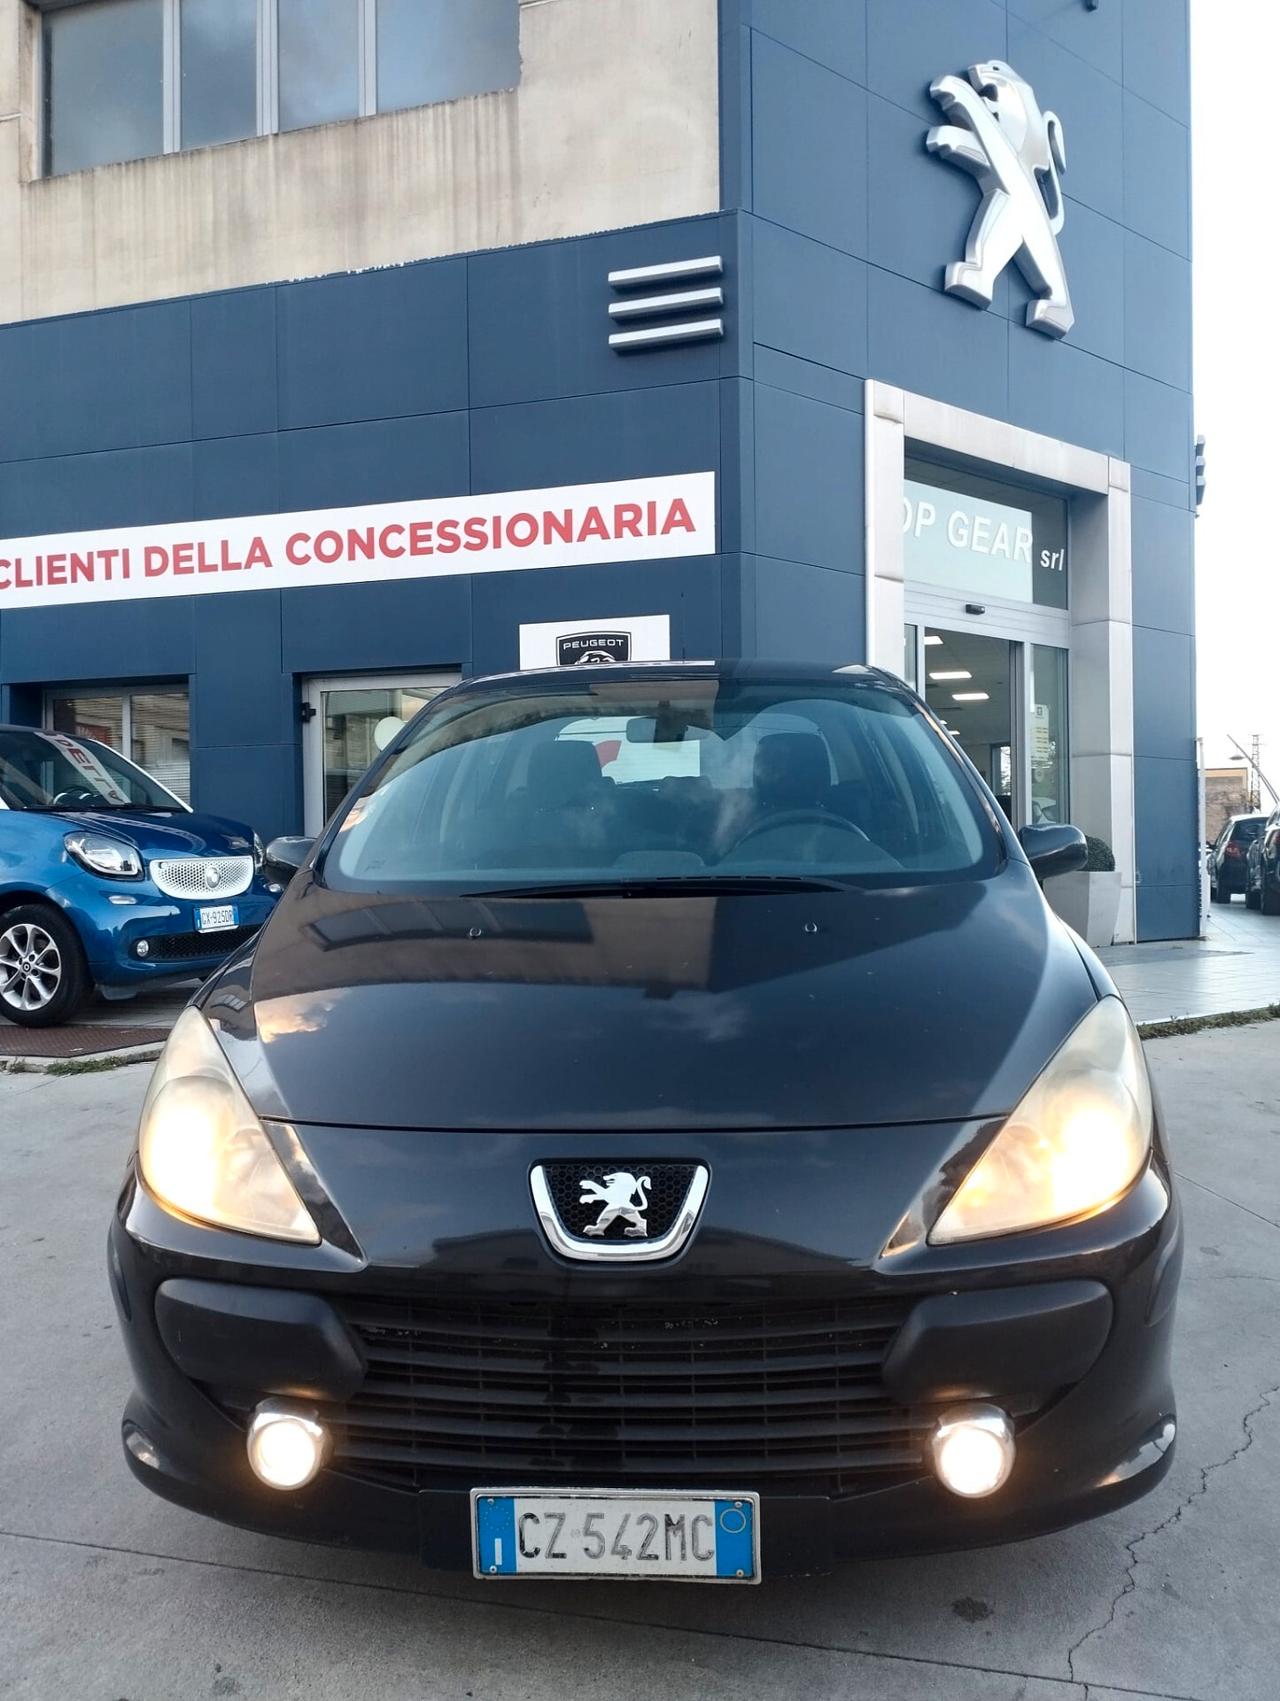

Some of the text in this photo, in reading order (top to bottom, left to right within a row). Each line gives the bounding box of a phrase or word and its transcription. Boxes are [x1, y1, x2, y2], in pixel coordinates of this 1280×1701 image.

[144, 537, 273, 577] DELLA
[285, 498, 696, 566] CONCESSIONARIA
[948, 511, 1033, 563] GEAR
[1040, 549, 1064, 571] srl
[563, 640, 624, 650] PEUGEOT
[583, 1512, 714, 1561] 542MC
